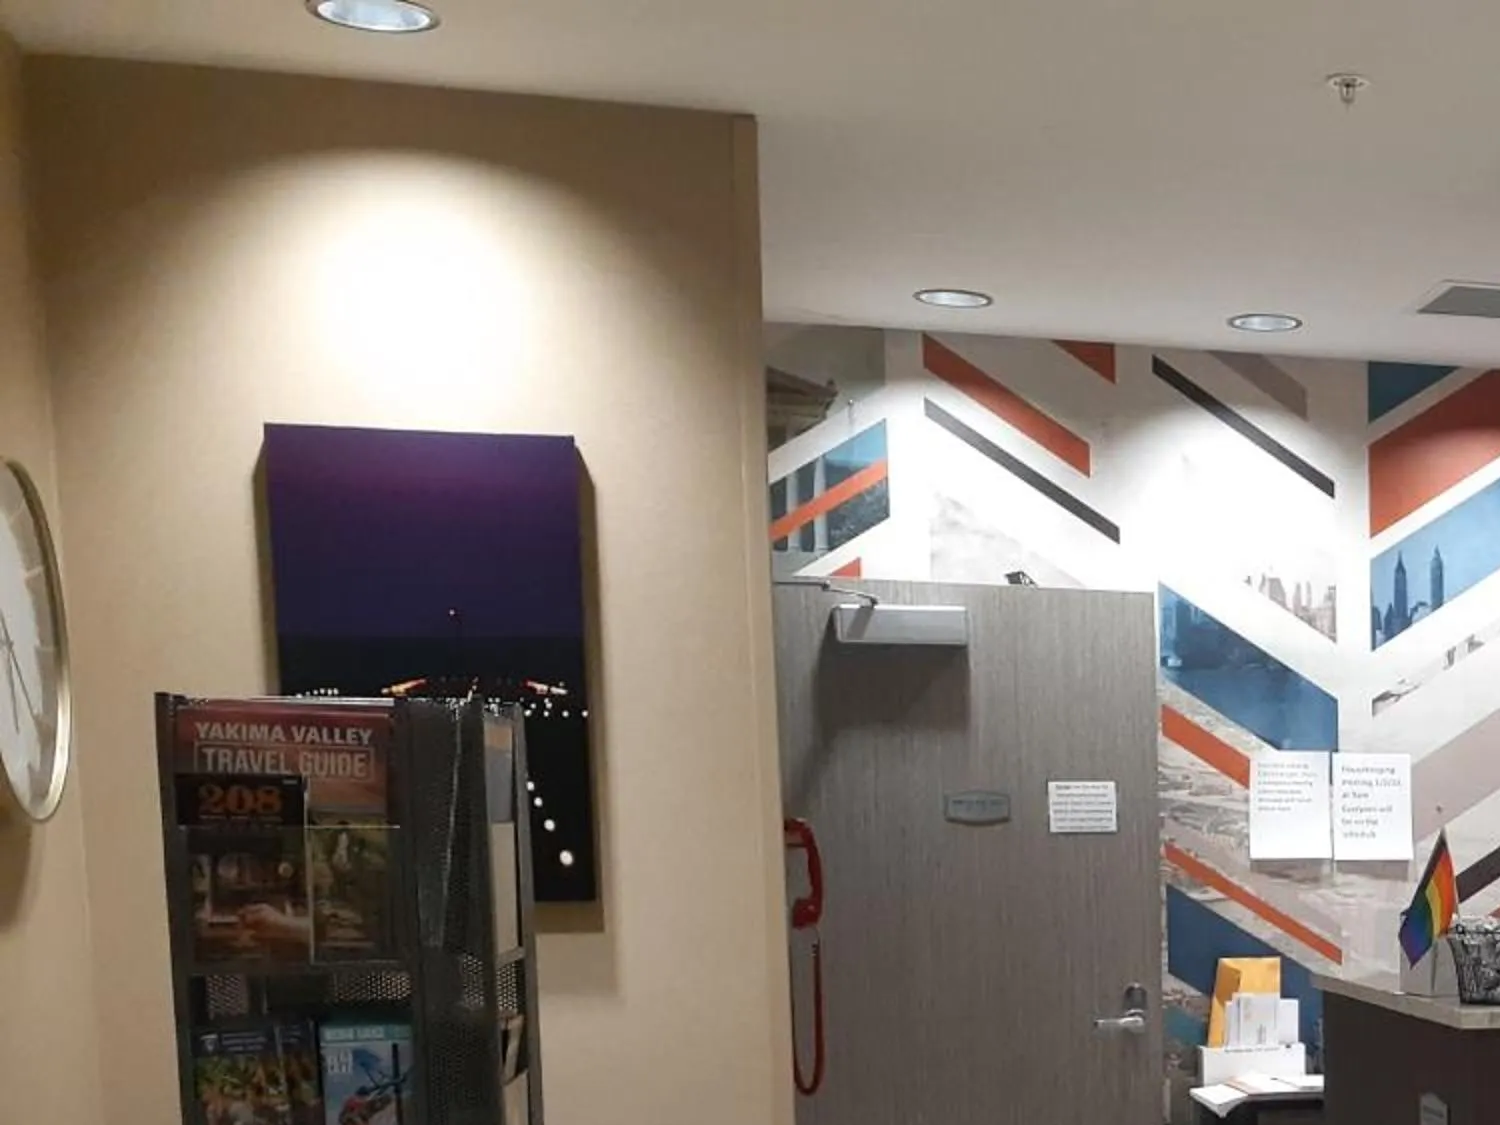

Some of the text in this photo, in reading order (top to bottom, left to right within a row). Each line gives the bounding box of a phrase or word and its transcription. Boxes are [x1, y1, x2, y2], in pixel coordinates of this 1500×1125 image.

[195, 721, 373, 746] YAKIMA VALLEY
[203, 748, 367, 778] TRAVEL GUIDE
